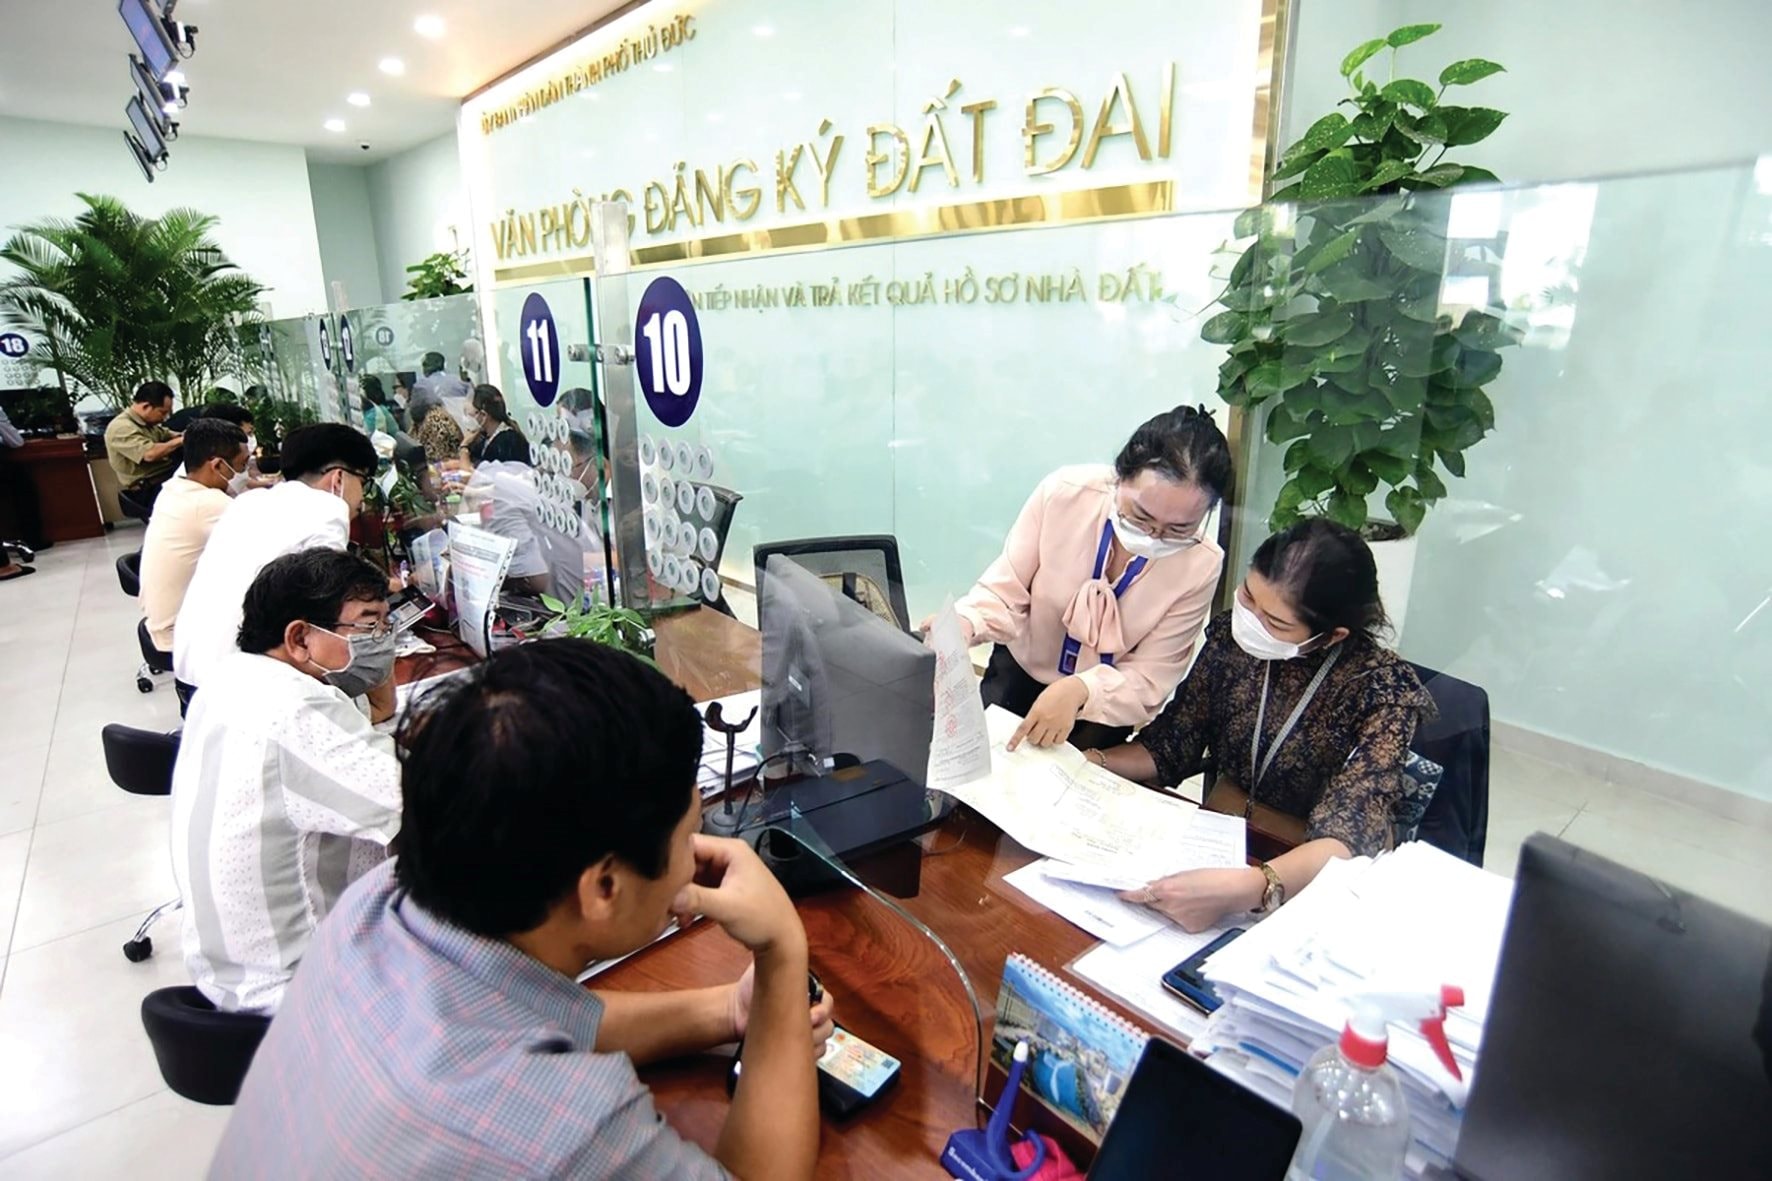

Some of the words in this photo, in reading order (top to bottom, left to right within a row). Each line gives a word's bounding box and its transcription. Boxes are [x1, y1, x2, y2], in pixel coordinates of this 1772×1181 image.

[631, 25, 658, 66] THỦ
[661, 14, 697, 53] ĐỨC
[490, 209, 537, 260] VĂN
[540, 187, 636, 252] PHÒ
[644, 161, 763, 236] ĐĂNG
[776, 119, 845, 213] KÝ
[865, 78, 998, 199] ĐẤT
[1021, 61, 1177, 177] ĐAI
[734, 284, 779, 314] NHẬN
[781, 281, 807, 308] VÀ
[810, 276, 843, 308] TRẢ
[847, 274, 881, 306] KẾT
[886, 271, 938, 306] QUẢ
[944, 265, 980, 304] HỒ
[984, 272, 1020, 304] SƠ
[1025, 266, 1088, 303] NHÀ
[1, 337, 25, 353] 18
[527, 319, 553, 383] 11
[643, 310, 691, 396] 10
